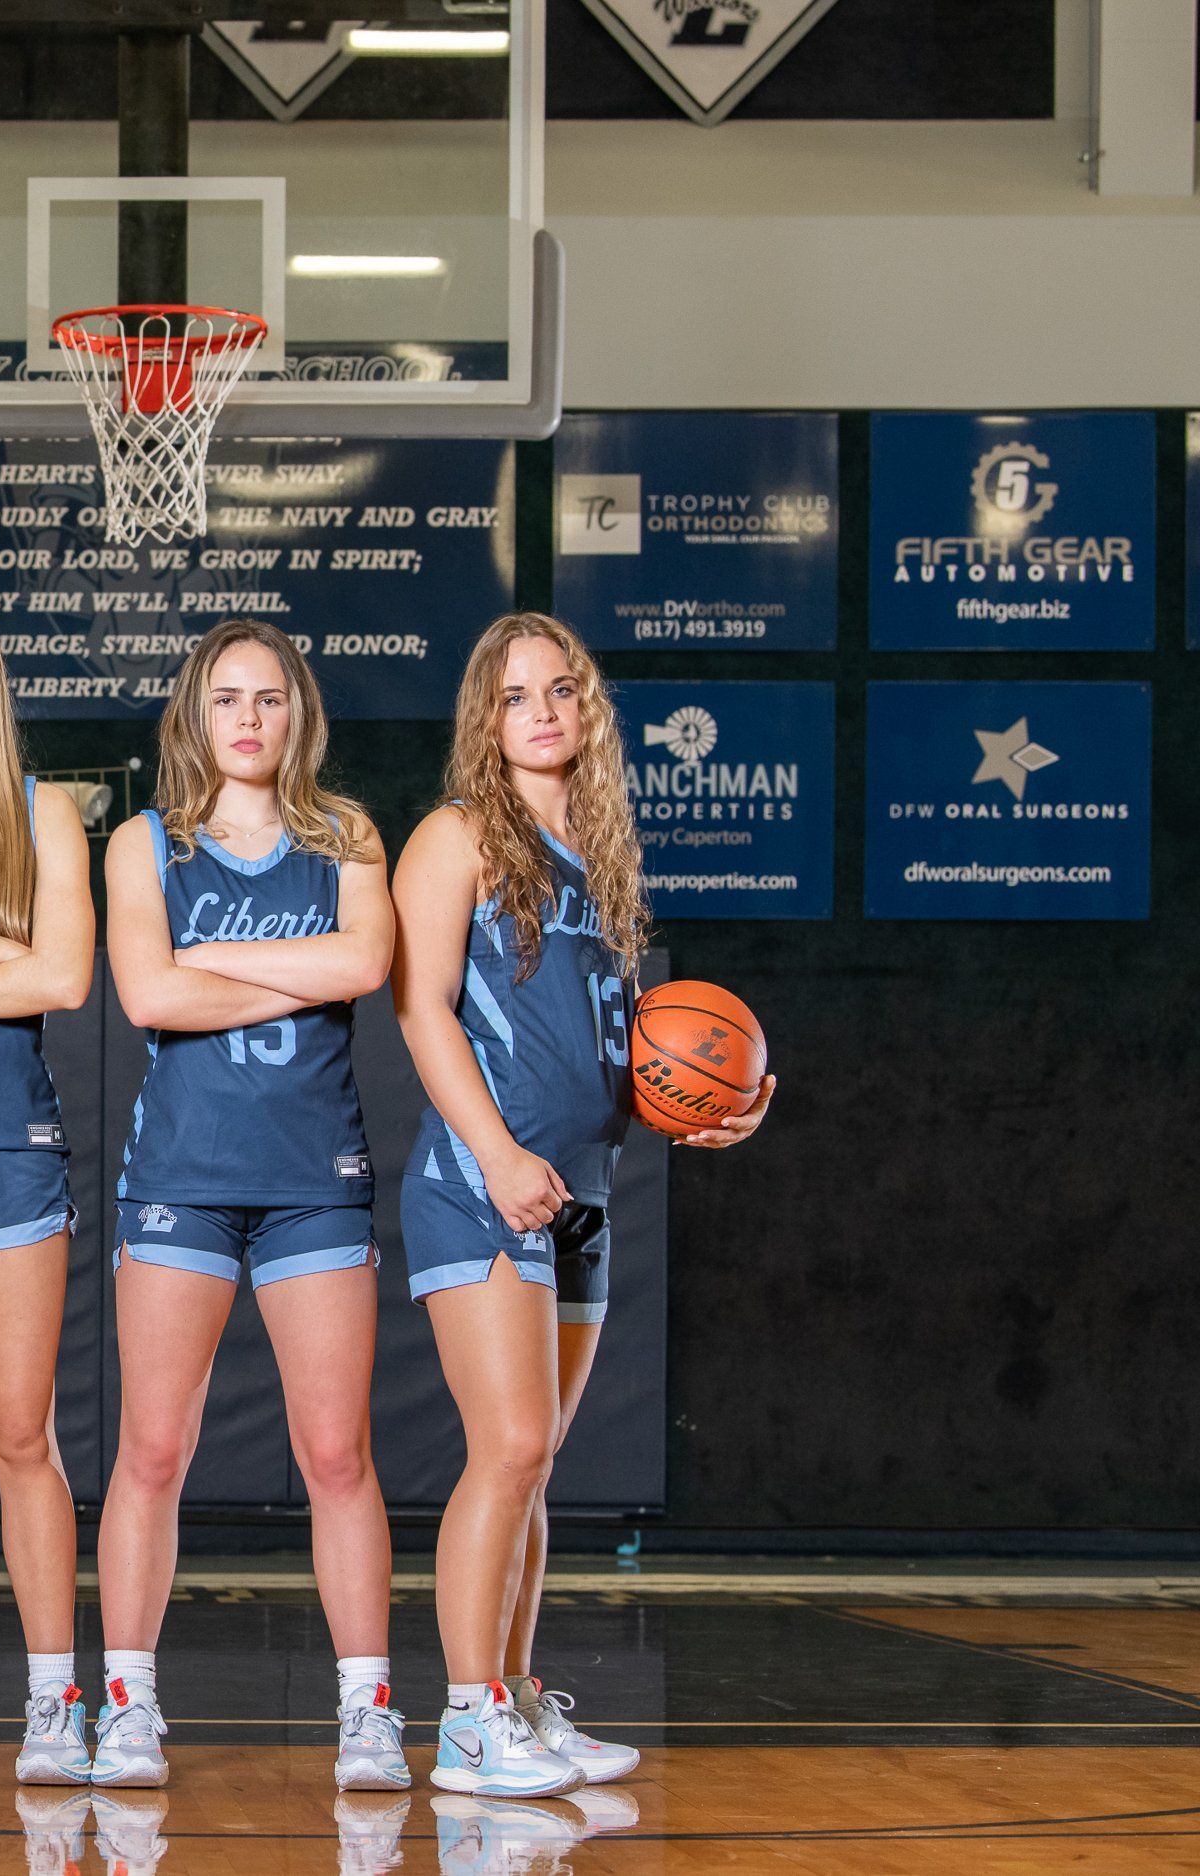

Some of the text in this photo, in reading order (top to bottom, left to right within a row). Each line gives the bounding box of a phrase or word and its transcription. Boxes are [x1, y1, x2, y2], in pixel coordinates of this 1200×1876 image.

[180, 464, 263, 485] EVER
[275, 464, 346, 485] SWAY.
[577, 495, 619, 531] TC
[647, 495, 831, 512] TROPHY CLUB
[218, 507, 271, 528] THE
[281, 507, 353, 528] NAVY
[357, 507, 416, 528] AND
[426, 507, 500, 528] GRAY.
[647, 515, 830, 533] ORTHODONTICS
[61, 550, 140, 574] LORD,
[149, 550, 190, 570] WE
[199, 550, 283, 570] GROW
[288, 550, 322, 570] IN
[329, 550, 423, 574] SPIRIT;
[895, 537, 1133, 565] FIFTH GEAR
[894, 564, 1135, 583] AUTOMOTIVE
[27, 592, 85, 613] HIM
[178, 592, 292, 613] PREVAIL.
[614, 600, 786, 618] www.DrVortho.com
[957, 599, 1071, 624] fifthgear.biz
[634, 619, 766, 641] (817) 491.3919
[322, 635, 428, 659] HONOR;
[625, 763, 799, 798] ANCHMAN
[889, 803, 1130, 820] DFW ORAL SURGEONS
[671, 827, 753, 849] Caperton
[903, 861, 1112, 888] dfworalsurgeons.com
[180, 892, 334, 944] Liberty
[586, 972, 630, 1067] 13
[633, 1058, 732, 1118] Baden
